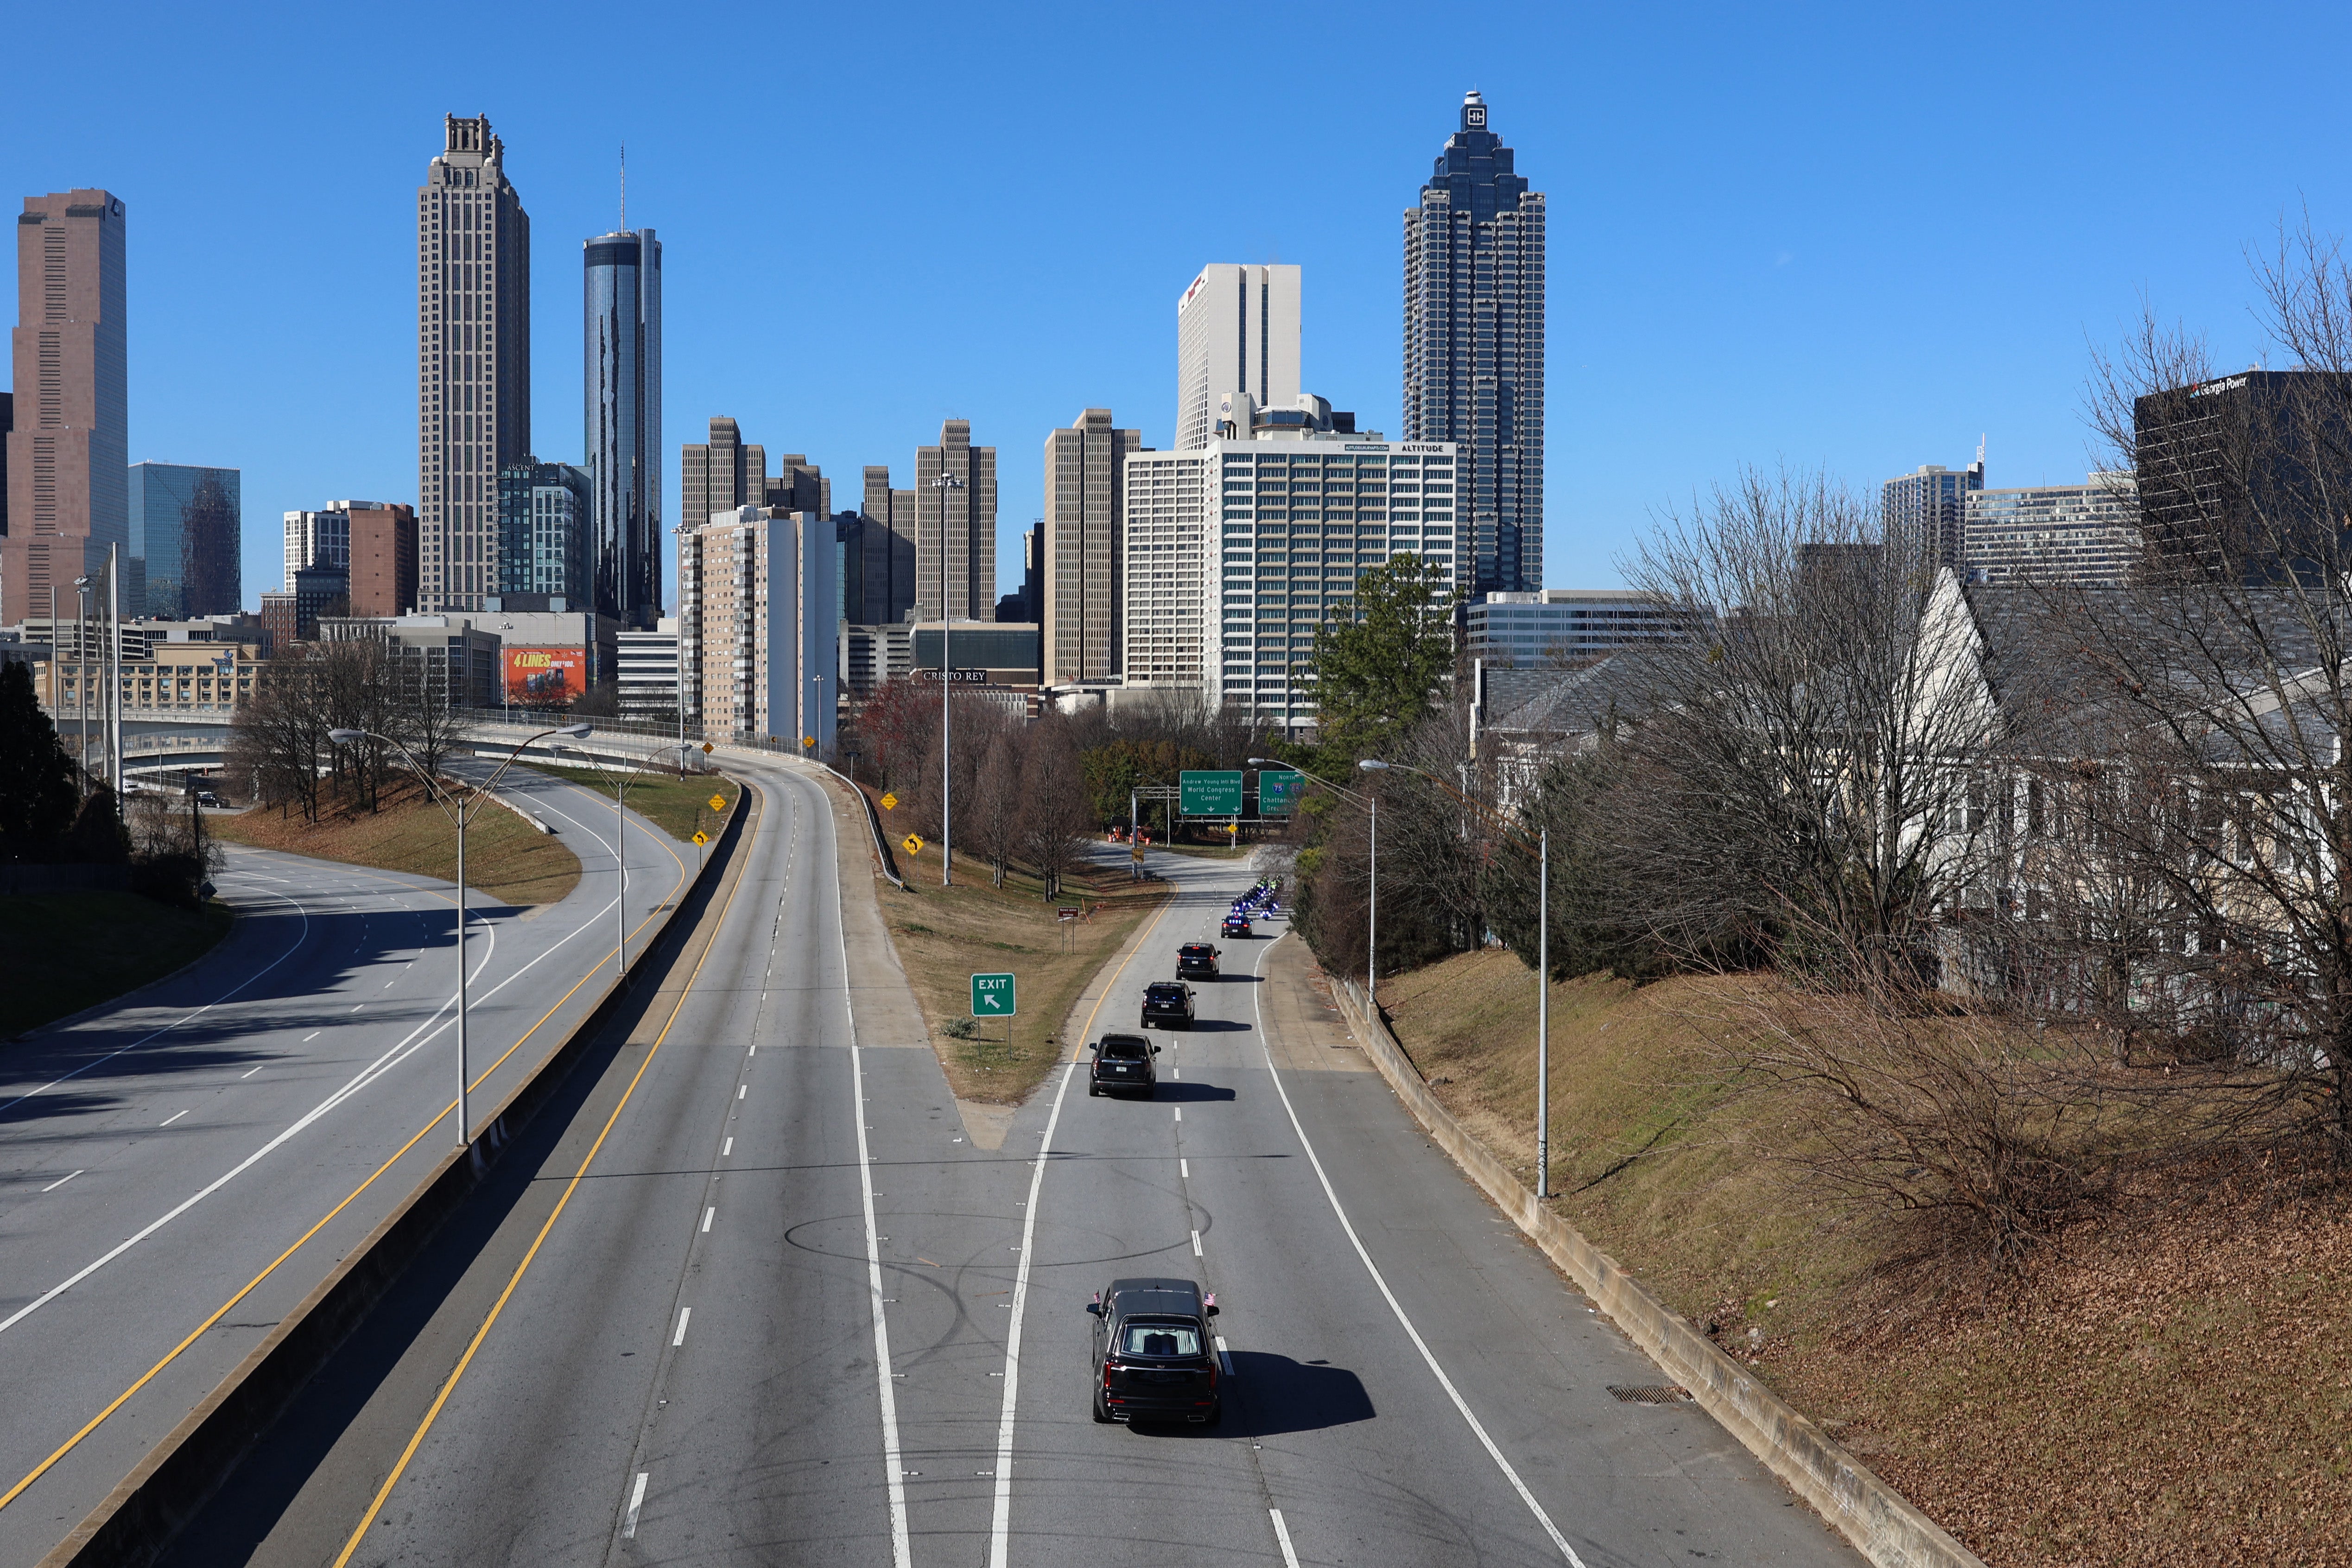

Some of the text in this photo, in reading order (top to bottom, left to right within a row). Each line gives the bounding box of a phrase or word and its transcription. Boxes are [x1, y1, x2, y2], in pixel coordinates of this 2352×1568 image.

[2226, 377, 2246, 390] Power
[514, 654, 521, 667] 4
[522, 654, 551, 667] LINES
[966, 672, 985, 680] REY
[979, 979, 1006, 989] EXIT
